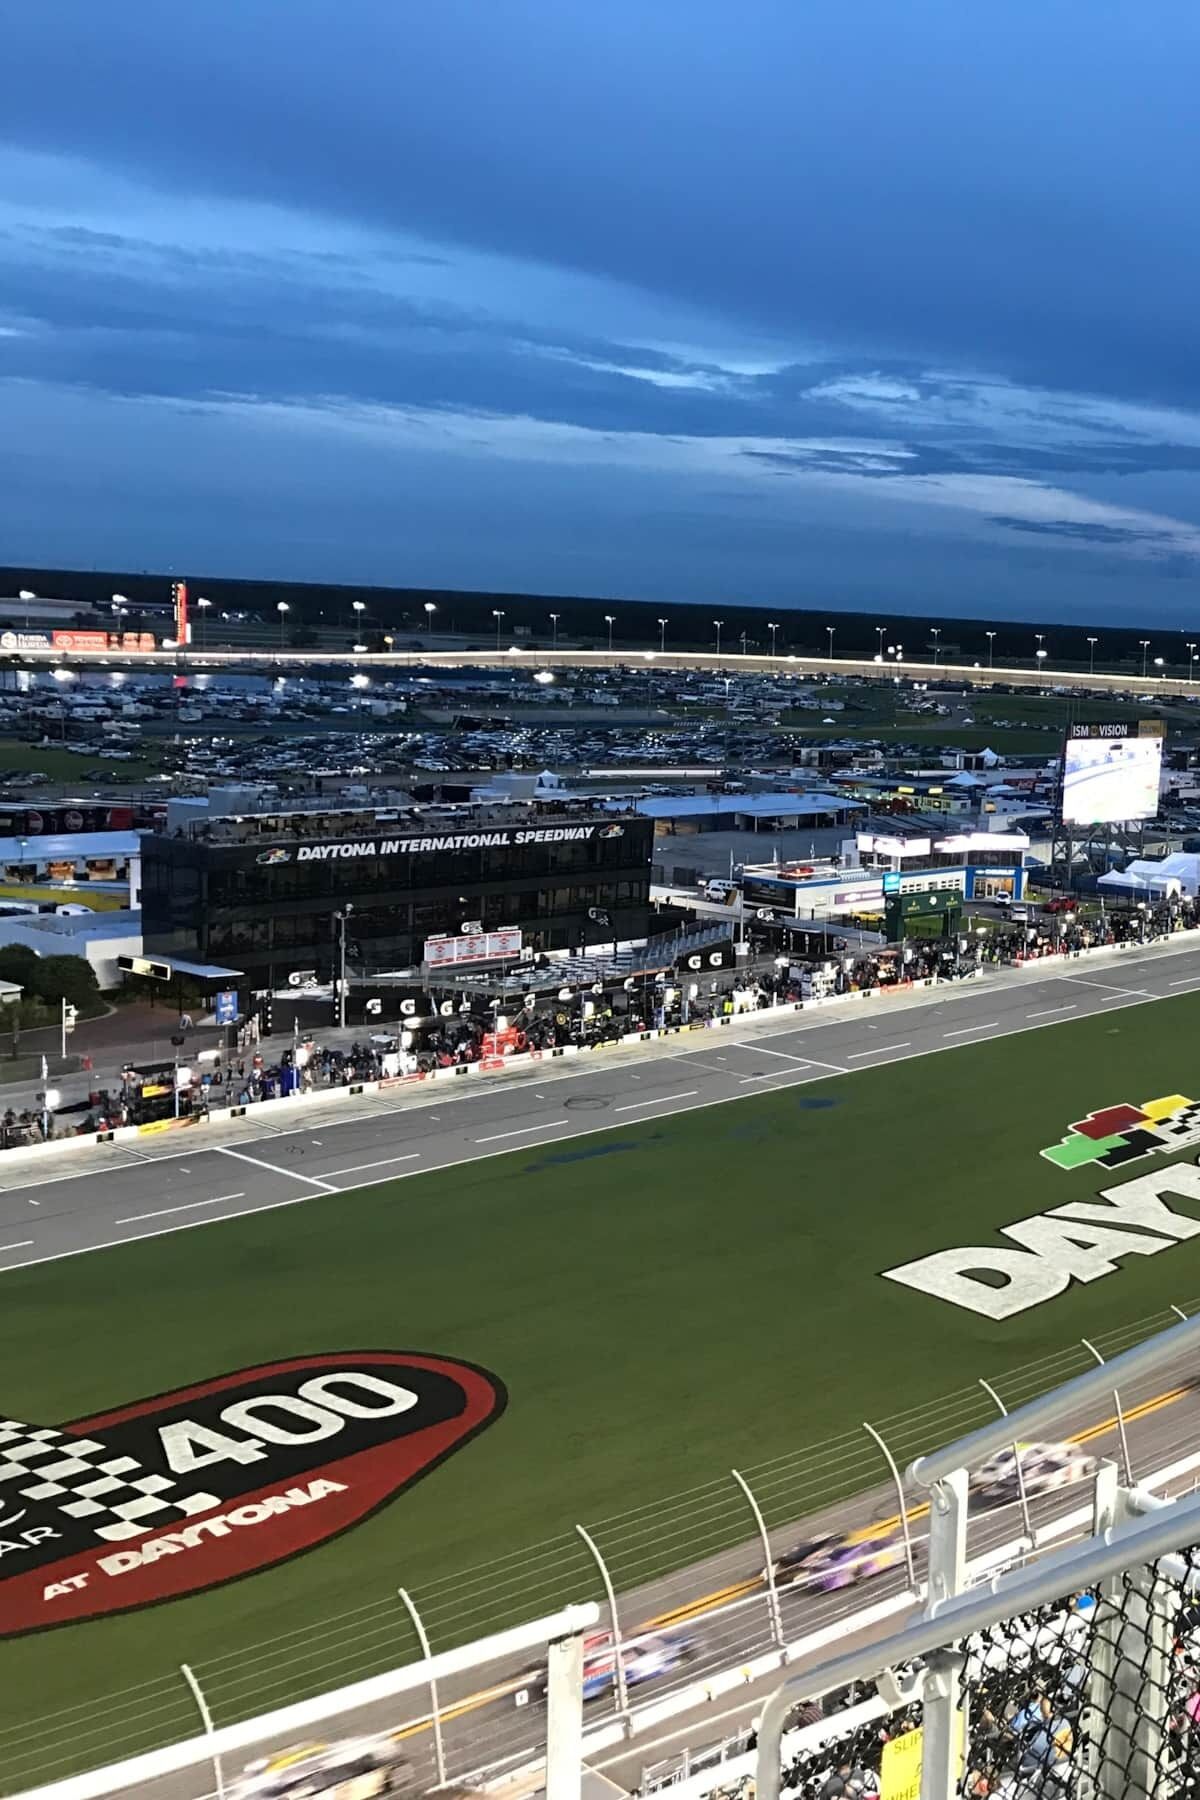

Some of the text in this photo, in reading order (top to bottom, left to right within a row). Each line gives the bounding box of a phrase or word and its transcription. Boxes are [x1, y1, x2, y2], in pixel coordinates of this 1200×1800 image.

[1073, 725, 1089, 736] ISM
[1099, 724, 1128, 736] VISION
[297, 827, 595, 861] DAYTONA INTERNATIONAL SPEEDWAY
[688, 955, 701, 969] G
[709, 952, 723, 966] G
[400, 999, 416, 1015] G
[440, 1000, 453, 1016] G
[157, 1372, 419, 1474] 400
[44, 1478, 349, 1600] AT DAYTONA
